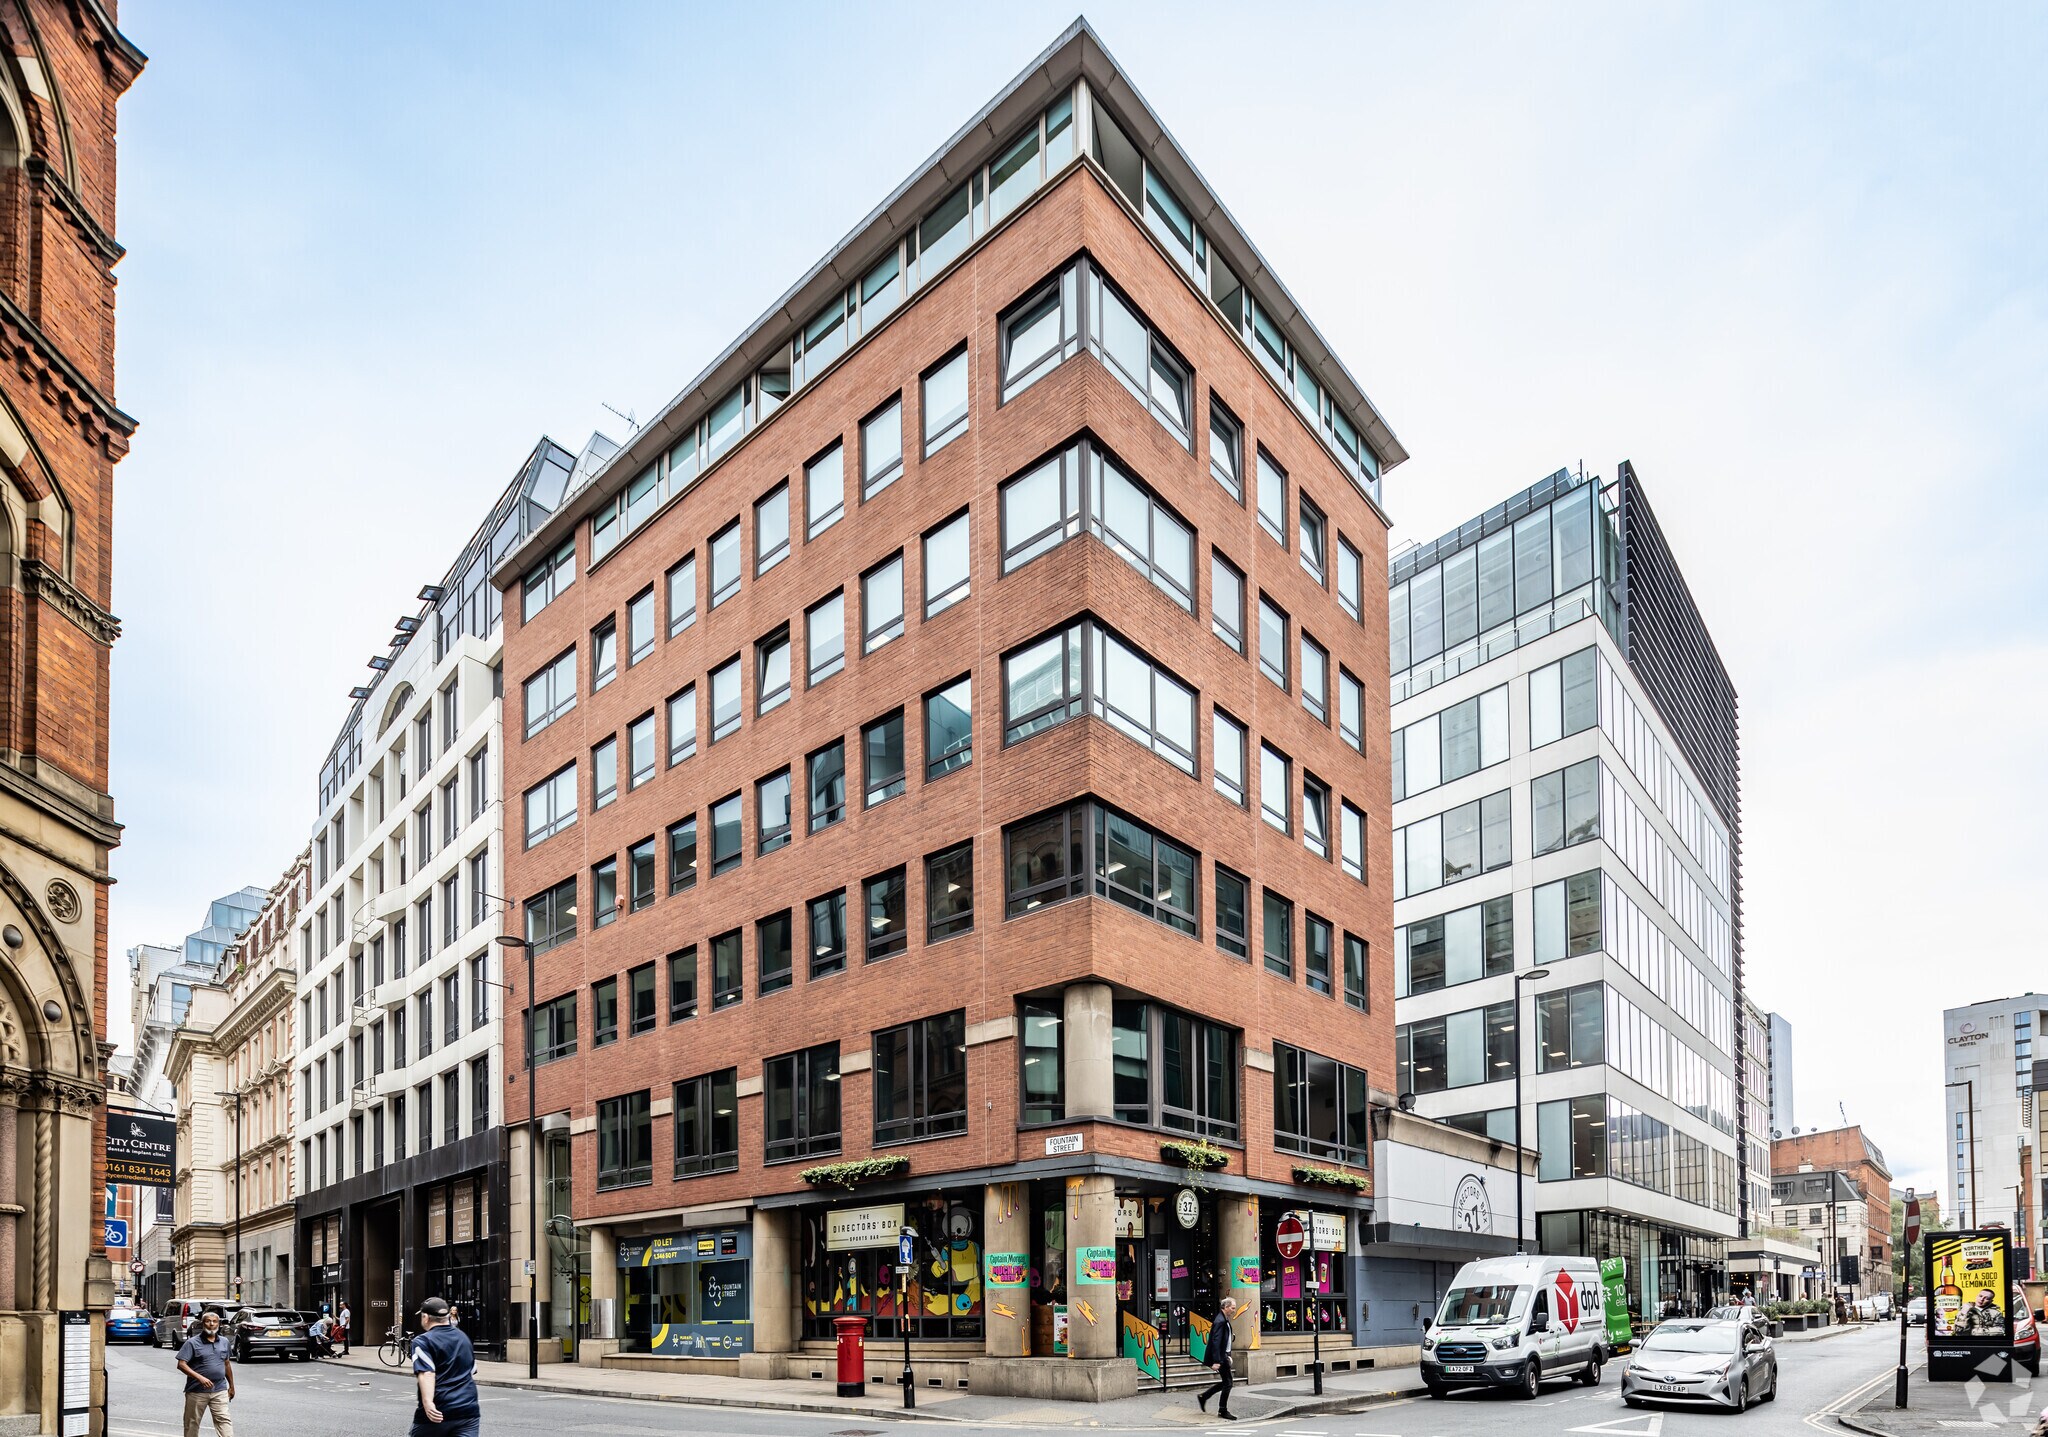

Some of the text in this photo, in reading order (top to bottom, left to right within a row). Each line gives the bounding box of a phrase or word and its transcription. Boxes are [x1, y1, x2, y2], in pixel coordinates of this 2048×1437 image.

[1947, 1032, 1989, 1045] CLAYTON
[130, 1139, 172, 1152] CENTRE
[1049, 1135, 1079, 1146] FOUNTAIN
[1053, 1143, 1075, 1153] STREET
[128, 1165, 146, 1174] 834
[149, 1167, 171, 1177] 1643
[1183, 1201, 1193, 1212] 37
[832, 1219, 897, 1234] DIRECTORS' BOX
[653, 1238, 673, 1247] TO LET
[1086, 1248, 1106, 1259] Captain
[990, 1254, 1008, 1265] Captain
[992, 1265, 1012, 1275] MUCK
[1090, 1260, 1111, 1271] MUCK
[1000, 1274, 1016, 1282] BREW
[1960, 1272, 1998, 1281] TRY A SOCO
[1961, 1280, 1996, 1288] LEMONADE
[1580, 1281, 1600, 1317] dpd
